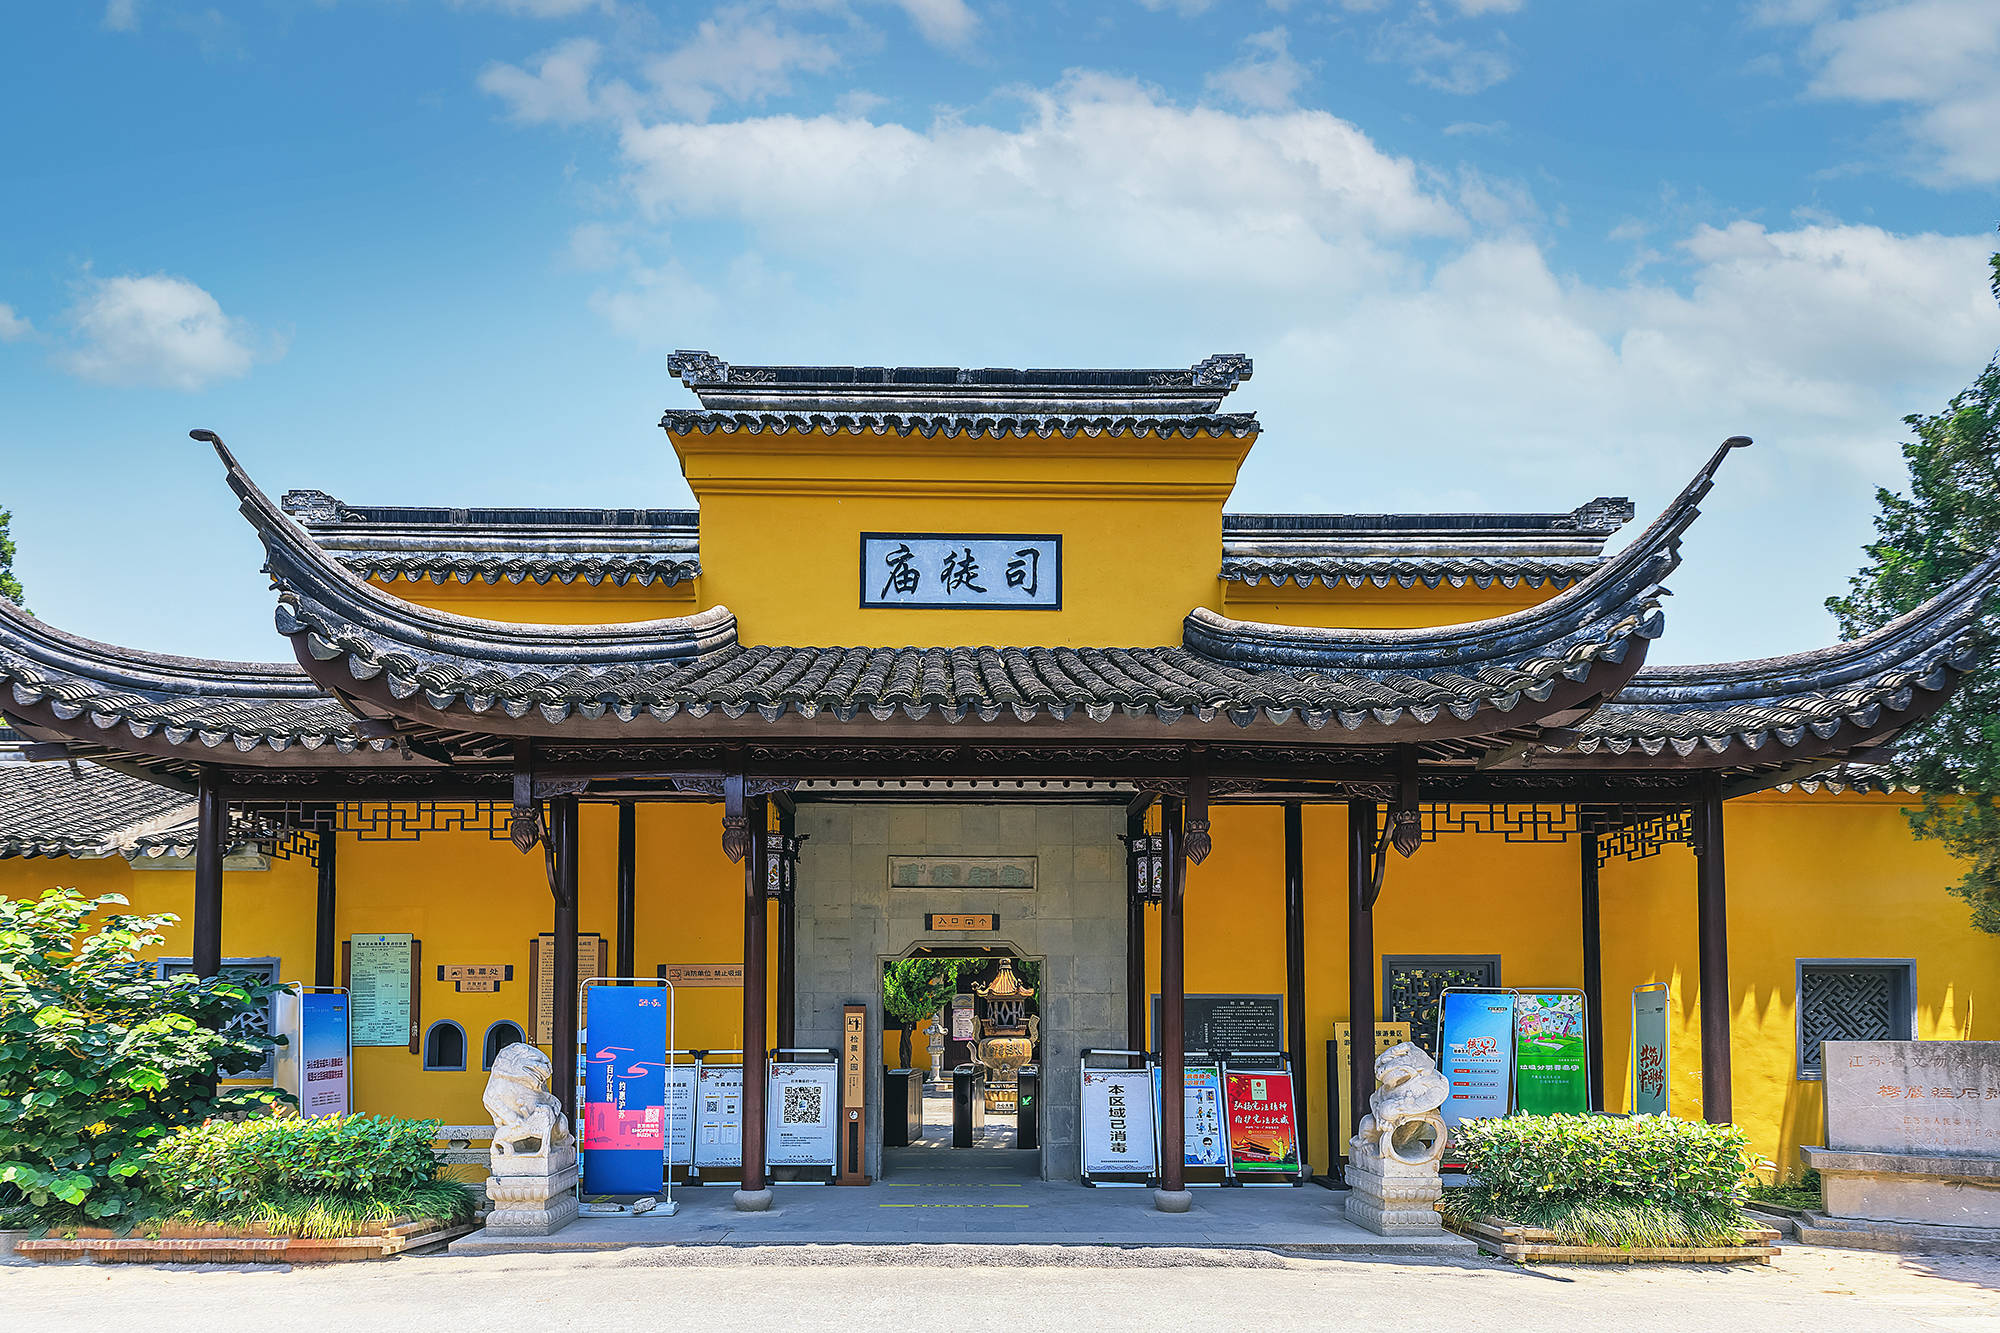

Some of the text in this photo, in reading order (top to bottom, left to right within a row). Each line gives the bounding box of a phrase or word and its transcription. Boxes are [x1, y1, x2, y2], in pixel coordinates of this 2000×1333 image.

[938, 917, 959, 925] 入口
[467, 967, 498, 976] 售票处
[606, 1064, 614, 1103] 百亿让利
[1233, 1101, 1288, 1112] 弘扬宪法精神
[1108, 1084, 1128, 1153] 本区域已消毒
[1235, 1113, 1289, 1125] 维护宪法权威
